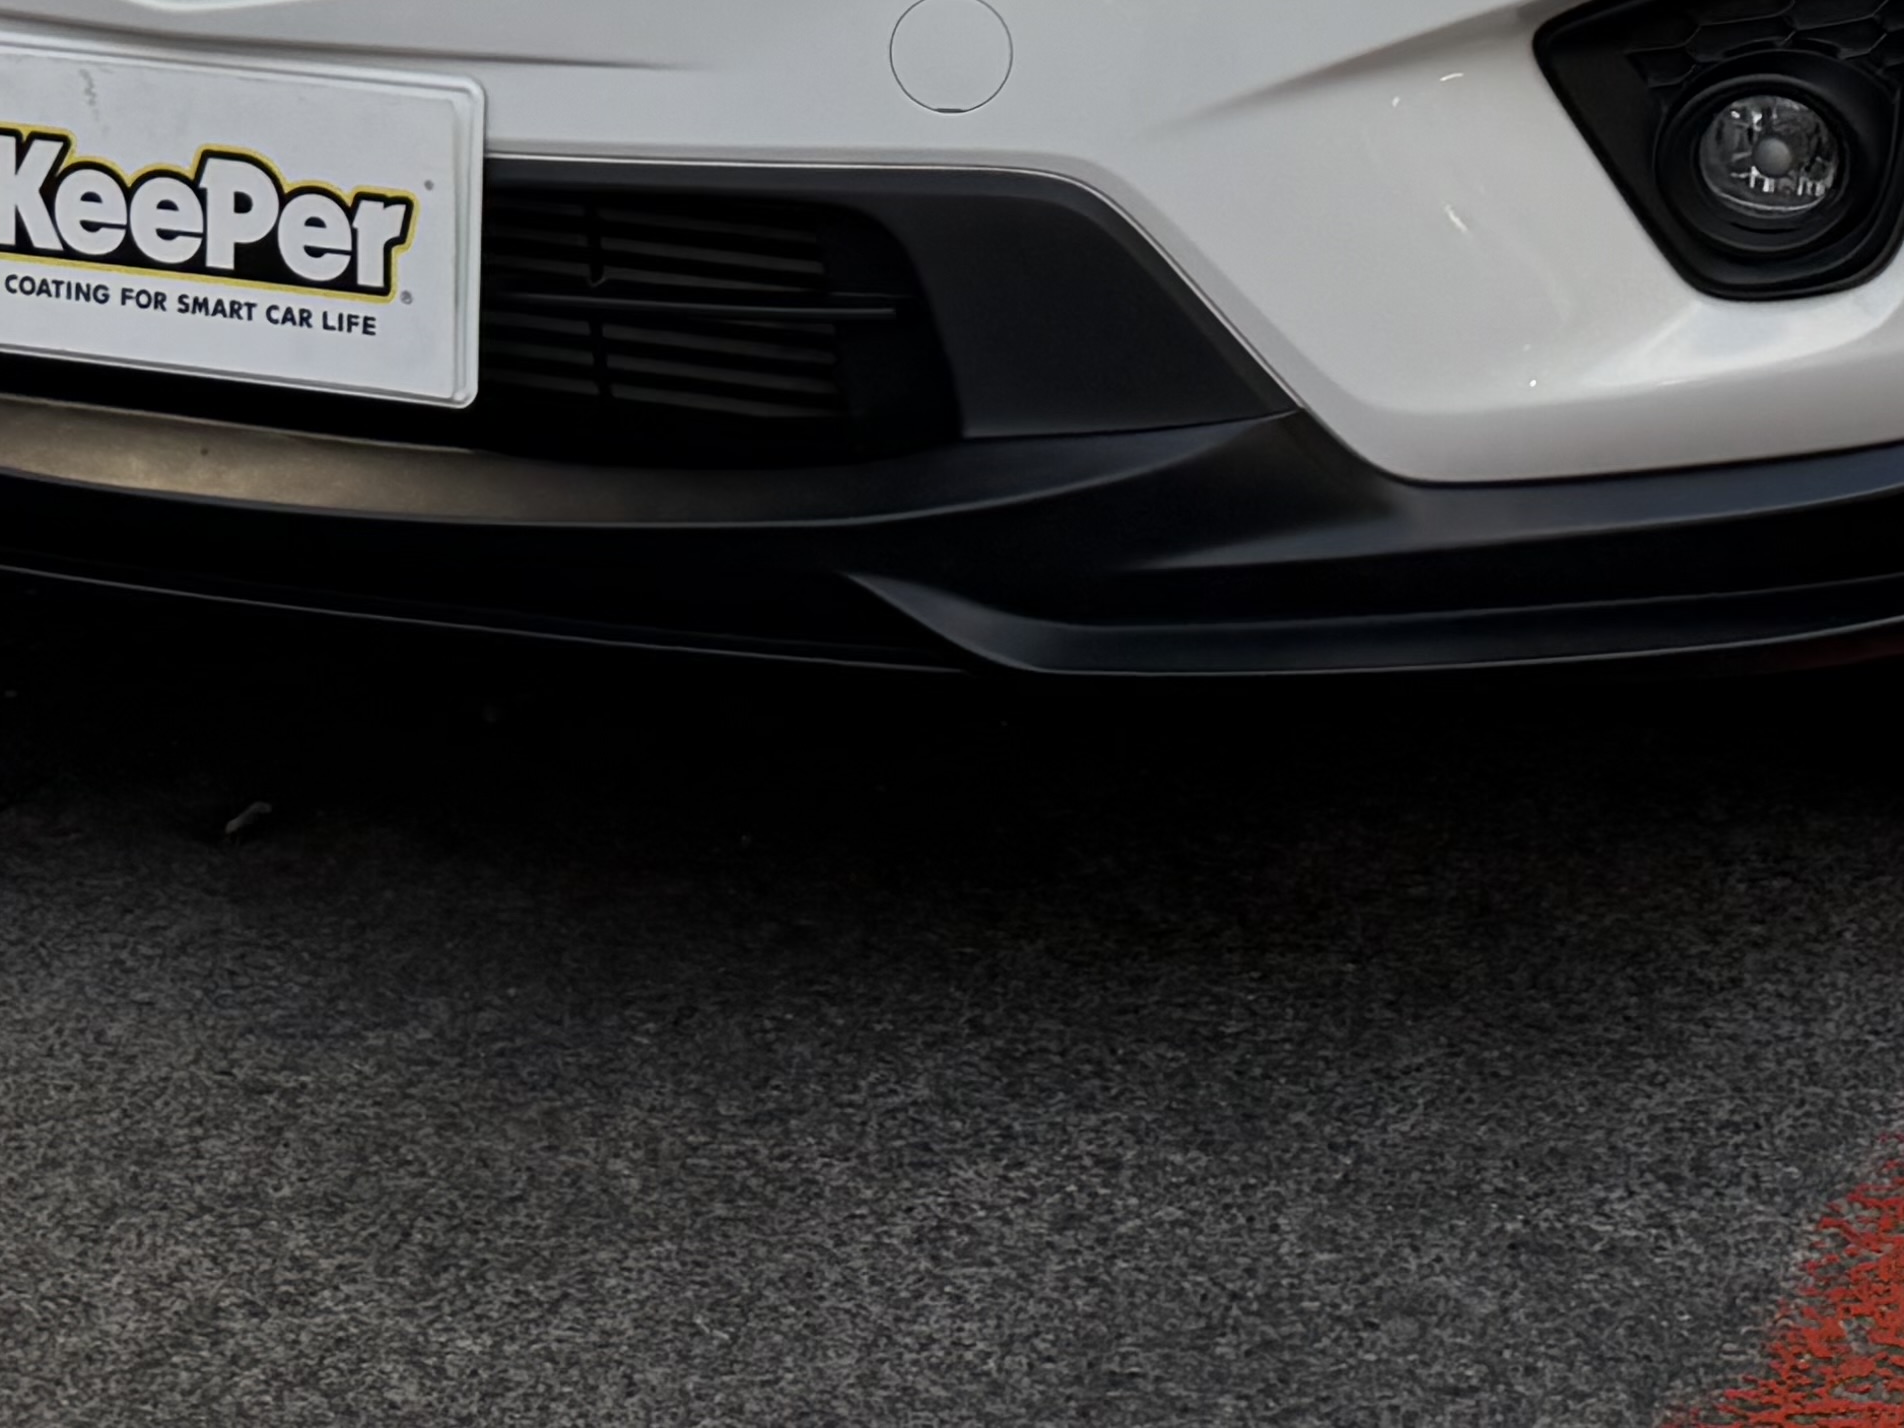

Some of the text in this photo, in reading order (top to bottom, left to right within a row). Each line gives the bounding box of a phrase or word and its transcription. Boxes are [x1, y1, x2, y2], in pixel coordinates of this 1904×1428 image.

[3, 273, 378, 336] COATING FOR SMART CAR LIFE
